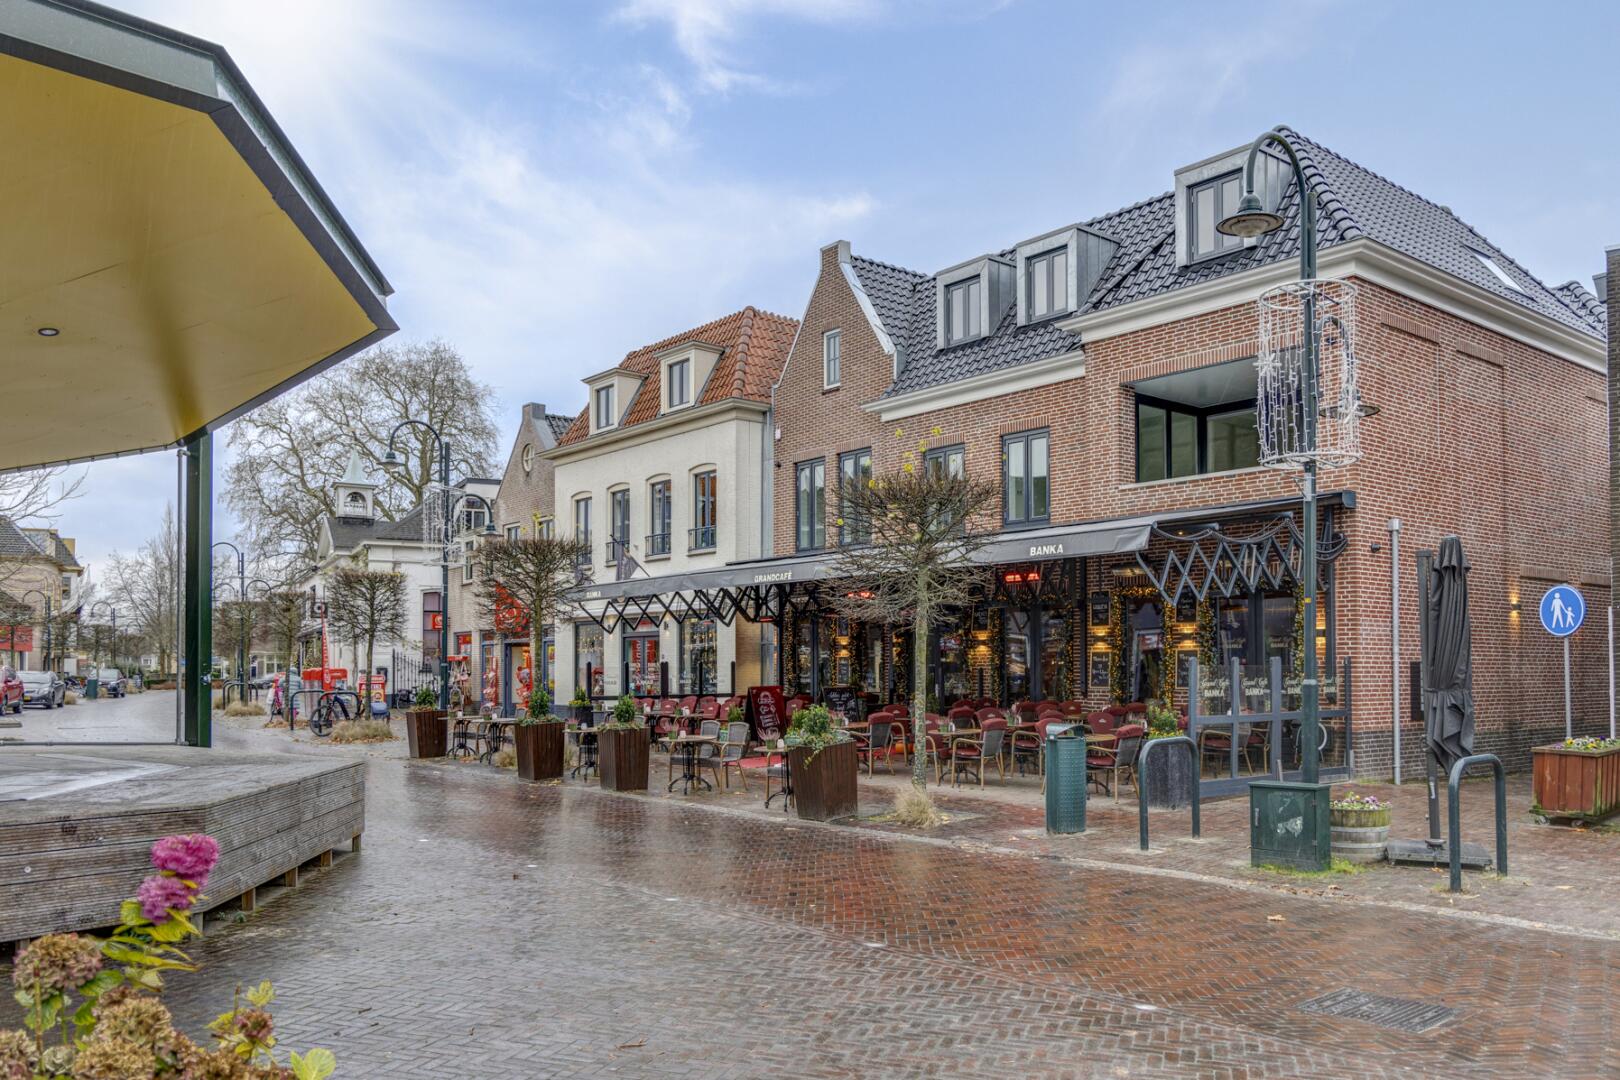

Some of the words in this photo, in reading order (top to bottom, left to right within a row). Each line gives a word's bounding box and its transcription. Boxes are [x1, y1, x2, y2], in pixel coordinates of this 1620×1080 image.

[1029, 543, 1064, 557] BANKA
[754, 569, 793, 583] GRANDCAFÉ
[1204, 689, 1225, 697] BANKA
[1245, 687, 1264, 696] BANKA
